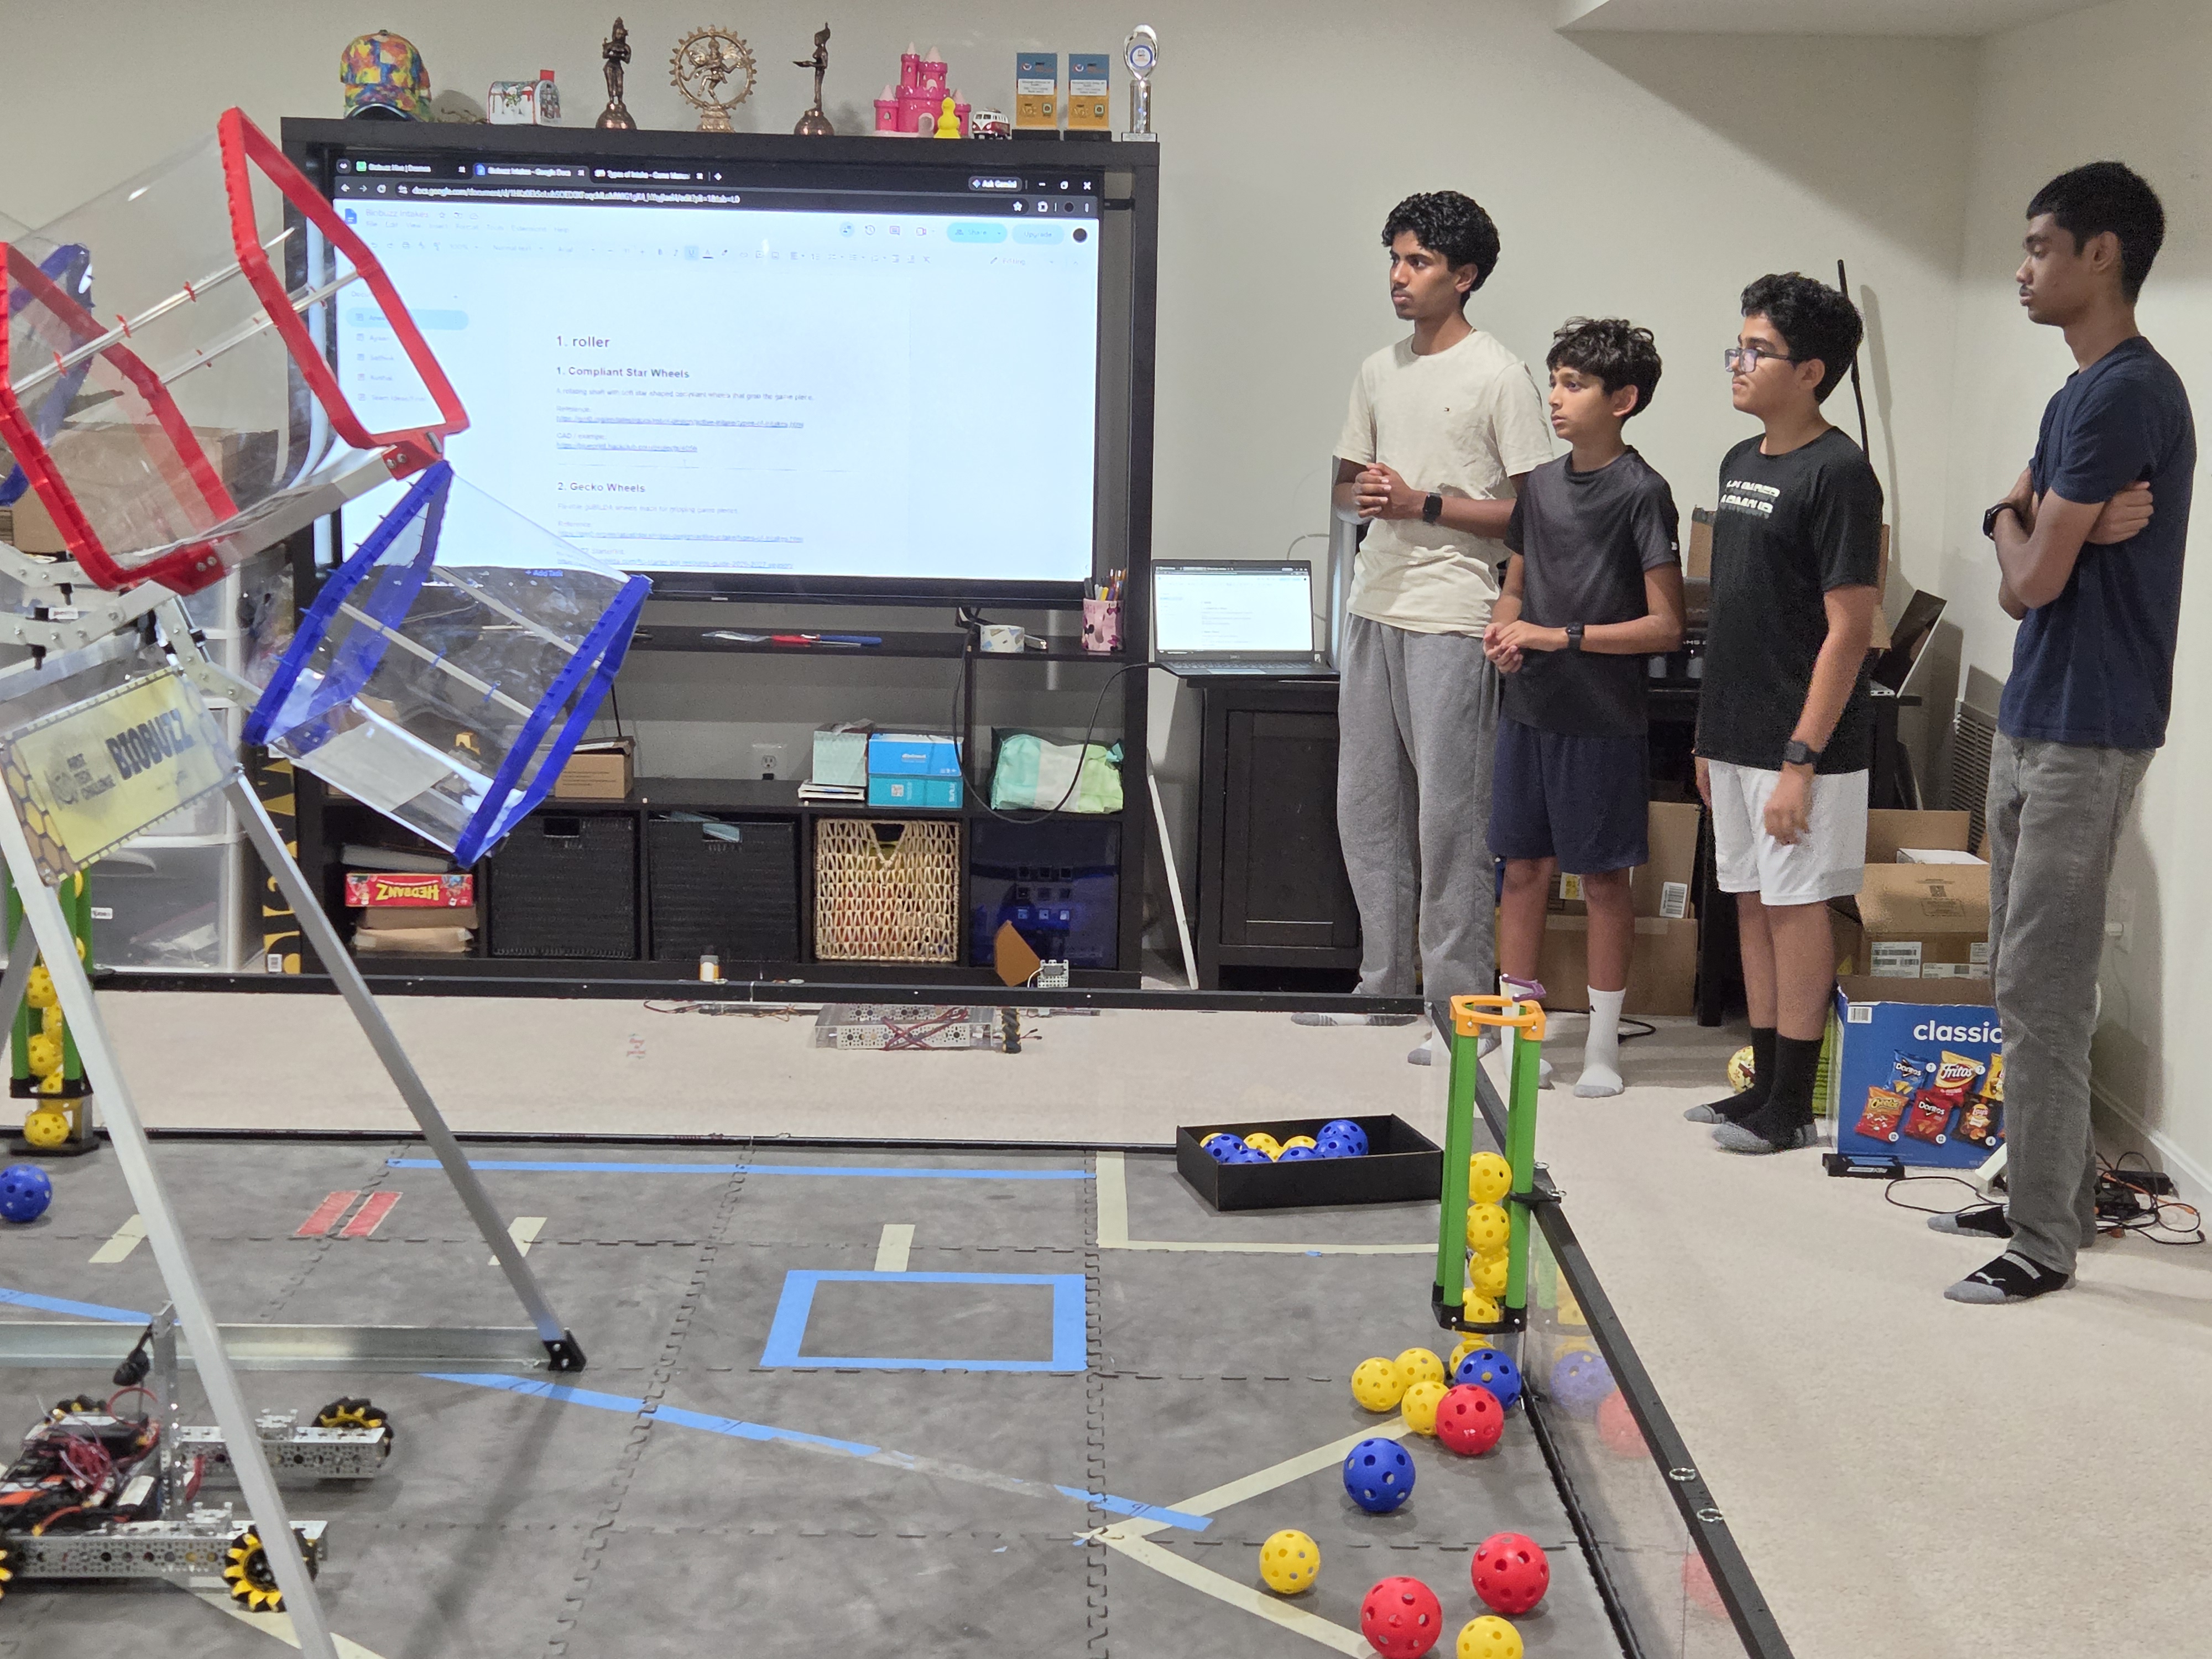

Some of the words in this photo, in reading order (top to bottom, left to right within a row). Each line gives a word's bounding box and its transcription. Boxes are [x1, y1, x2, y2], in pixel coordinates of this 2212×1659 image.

[366, 208, 398, 217] Biobuzz
[400, 210, 429, 218] Intakes
[1024, 231, 1052, 239] Upgrade
[1003, 257, 1025, 265] Editing
[557, 335, 568, 347] 1.
[572, 336, 611, 348] roller
[557, 367, 565, 375] 1.
[568, 366, 623, 378] Compliant
[626, 367, 648, 377] Star
[651, 368, 690, 378] Wheels
[557, 482, 566, 491] 2.
[570, 483, 603, 492] Gecko
[607, 483, 646, 492] Wheels
[106, 708, 196, 780] BIOBUZZ
[375, 883, 440, 901] HEDBANZ
[1913, 1020, 2002, 1044] classic
[1895, 1062, 1922, 1077] Doritos
[1940, 1063, 1974, 1079] Fritos
[1918, 1101, 1945, 1115] Doritos
